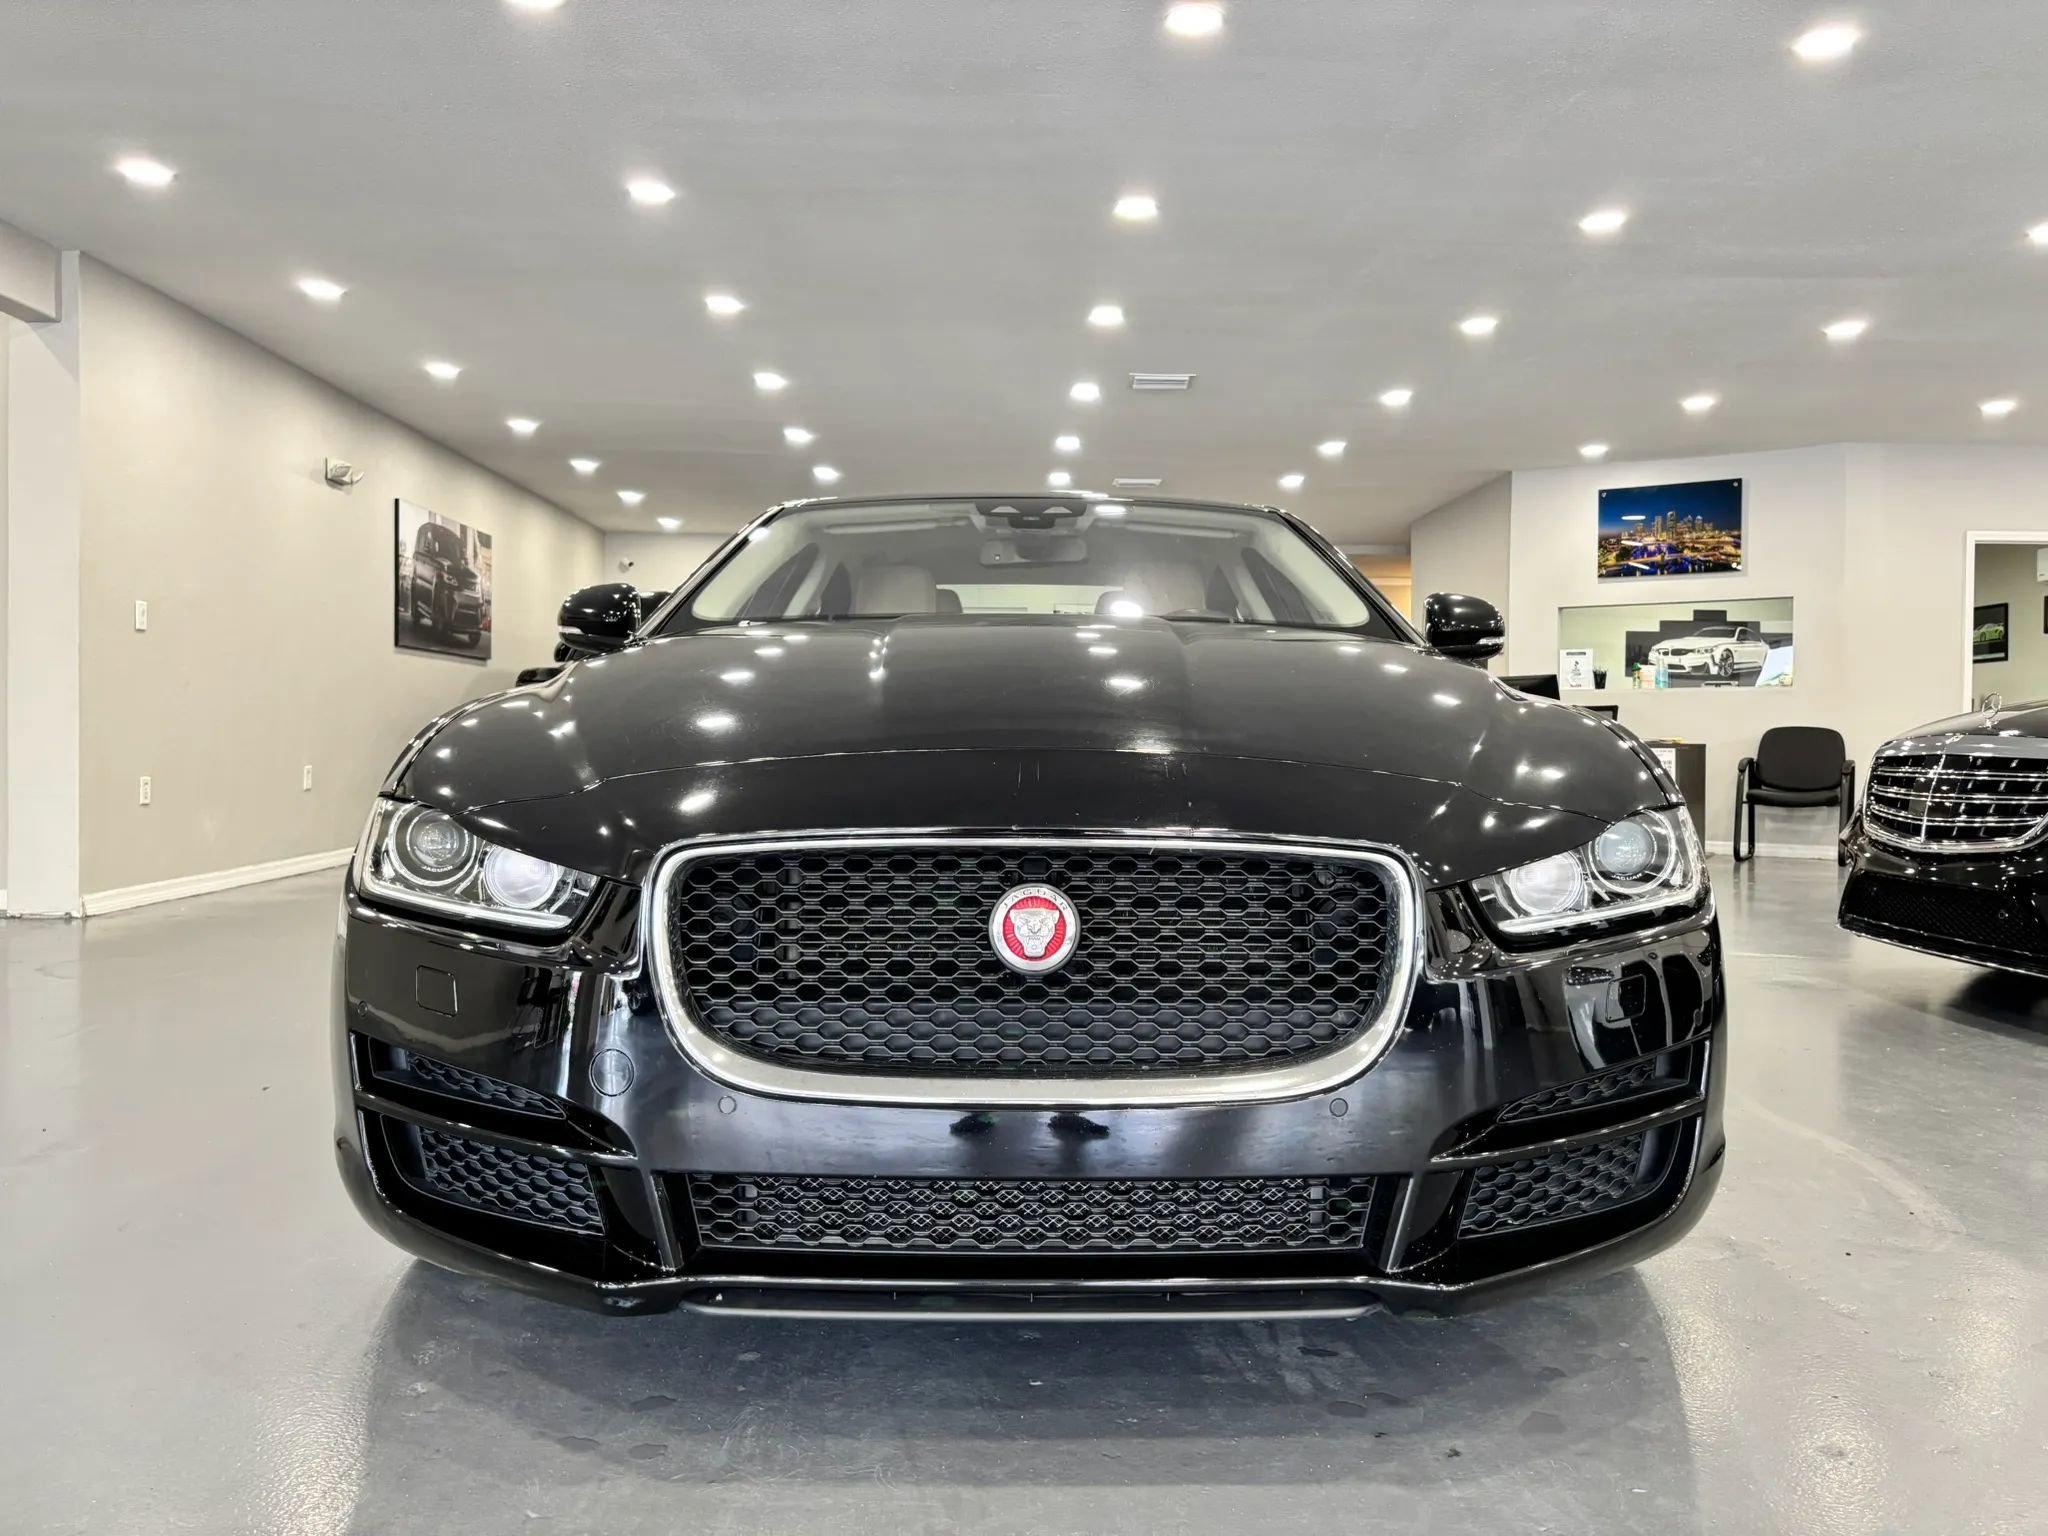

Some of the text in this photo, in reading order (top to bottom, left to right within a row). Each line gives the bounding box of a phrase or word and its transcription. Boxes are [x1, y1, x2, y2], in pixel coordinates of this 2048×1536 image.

[421, 865, 453, 873] JAGUAR
[1611, 873, 1643, 881] JAGUAR
[1002, 889, 1068, 911] JAGUAR
